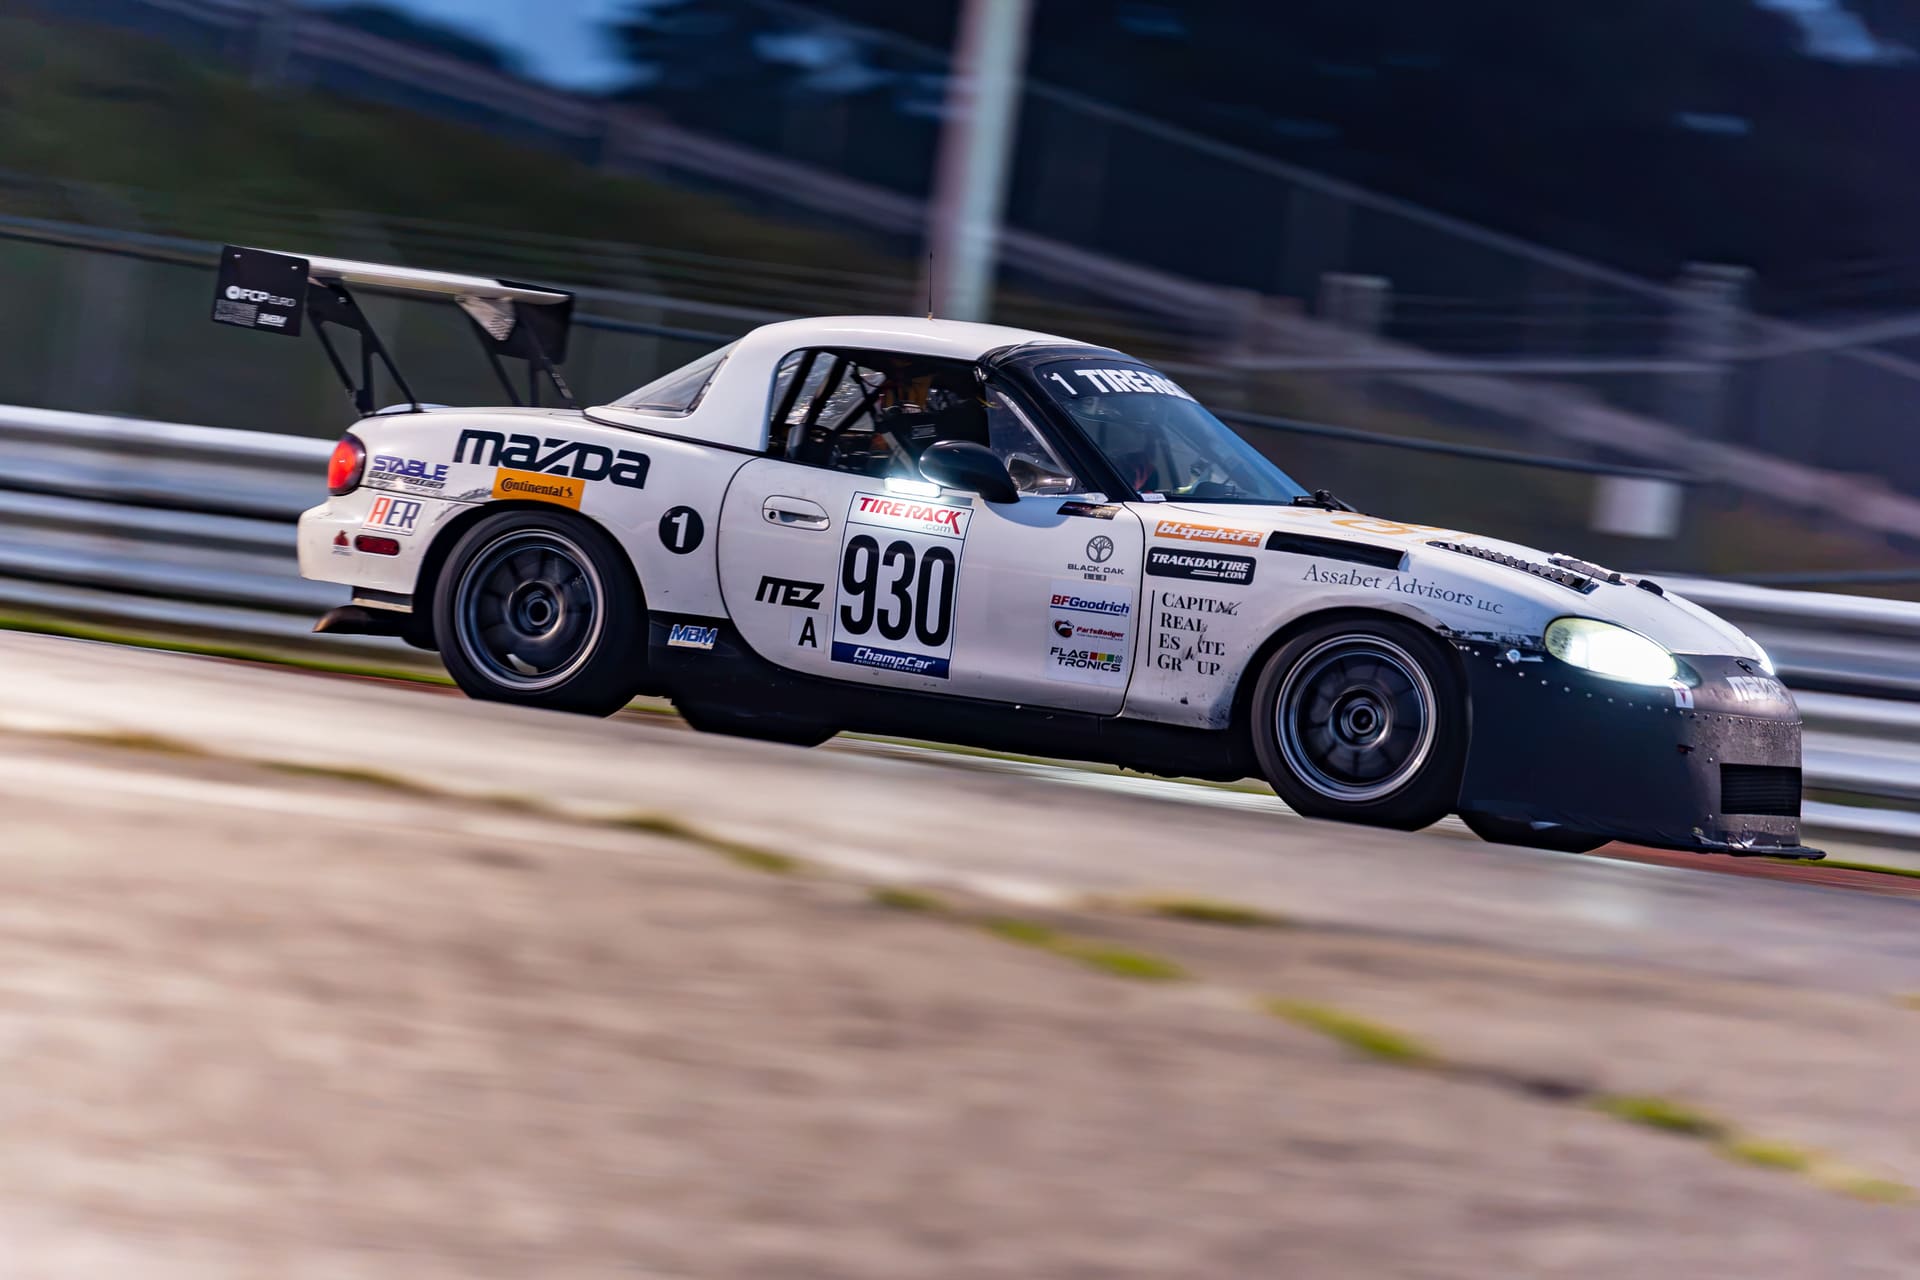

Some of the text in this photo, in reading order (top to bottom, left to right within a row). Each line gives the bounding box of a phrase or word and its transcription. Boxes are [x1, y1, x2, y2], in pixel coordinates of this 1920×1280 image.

[371, 454, 451, 482] STABLE
[501, 477, 565, 498] Continental
[367, 496, 422, 529] AER
[859, 497, 962, 535] TIRE RACK
[671, 512, 689, 548] 1
[922, 523, 952, 534] .com
[1157, 522, 1261, 544] blipshift
[1067, 563, 1125, 575] BLACK OAK
[1151, 552, 1251, 572] TRACKDAYTIRE
[840, 534, 956, 647] 930
[1303, 563, 1505, 615] Assabet Advisors LLC
[1051, 594, 1130, 614] BFGoodrich
[670, 623, 718, 645] MBM
[797, 616, 818, 648] A
[1076, 626, 1125, 639] PartsBadger
[853, 646, 933, 670] ChampCar
[1050, 646, 1089, 660] FLAG
[1057, 656, 1121, 673] TRONICS
[1157, 653, 1222, 676] GRUP
